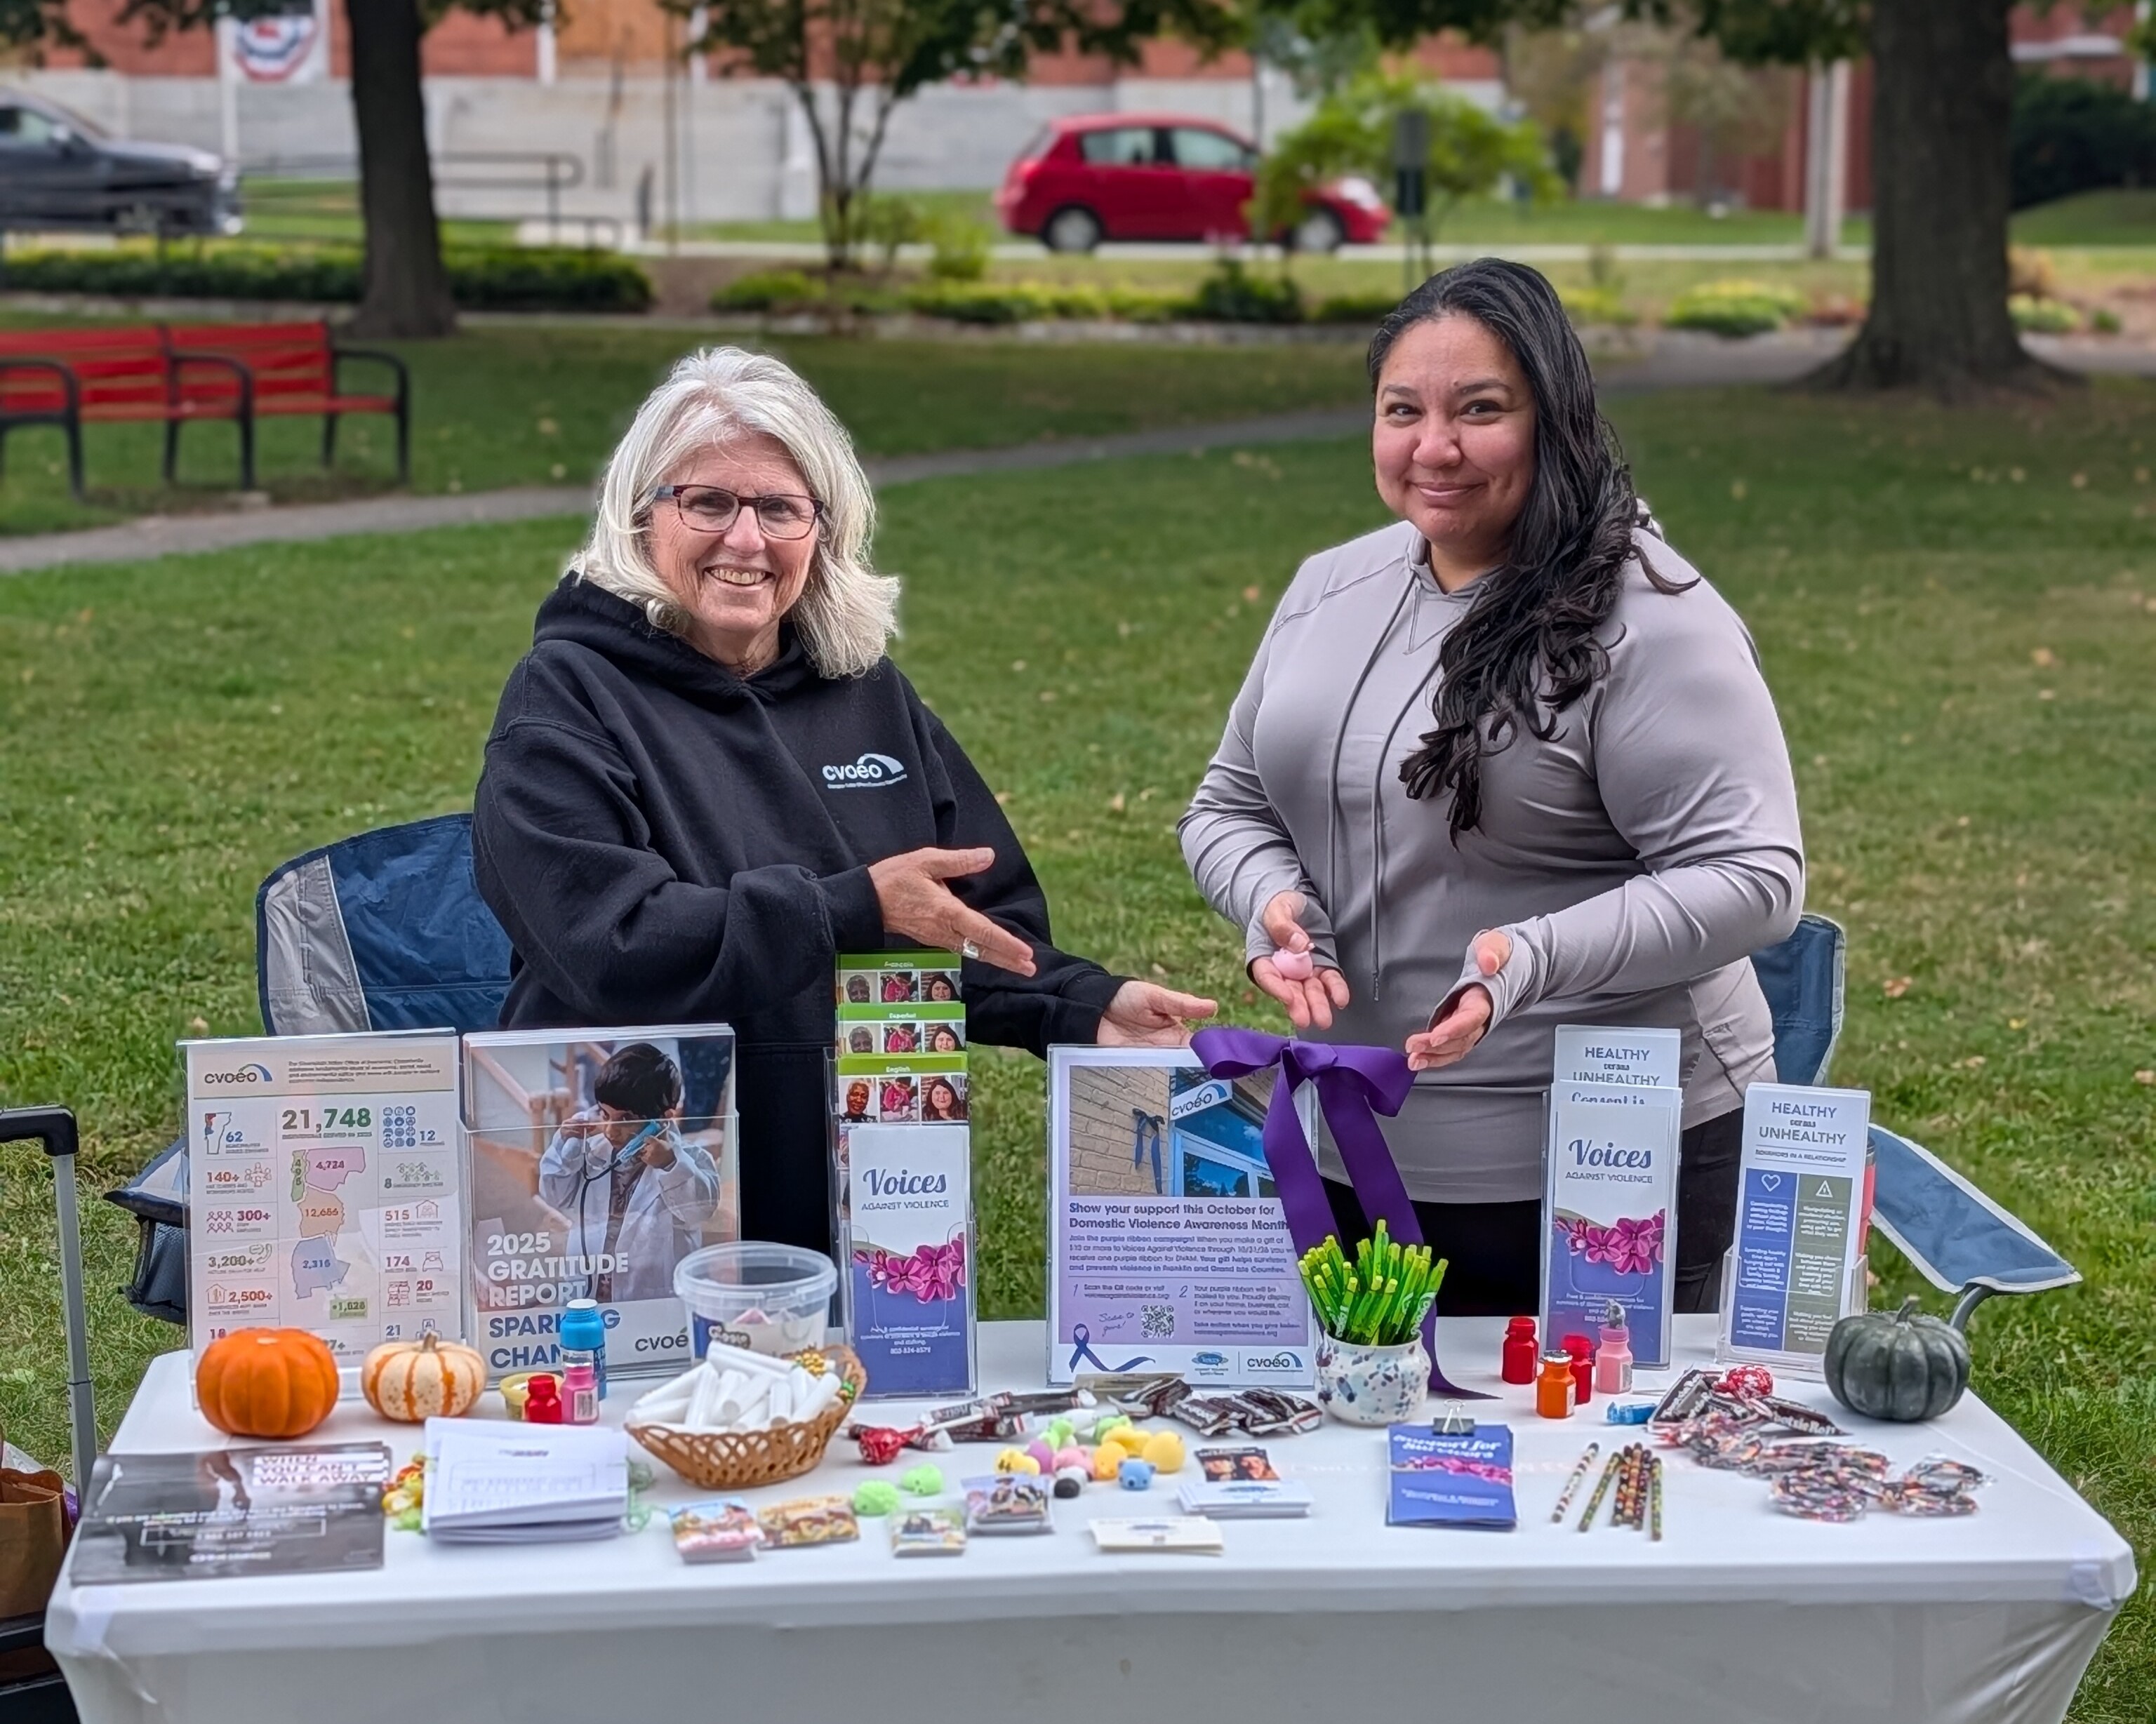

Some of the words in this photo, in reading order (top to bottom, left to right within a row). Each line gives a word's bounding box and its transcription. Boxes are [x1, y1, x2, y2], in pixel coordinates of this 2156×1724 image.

[1585, 1046, 1650, 1061] HEALTHY
[1573, 1071, 1661, 1086] UNHEALTHY
[1771, 1102, 1837, 1118] HEALTHY
[281, 1107, 372, 1132] 21,748
[225, 1131, 244, 1142] 62
[420, 1130, 436, 1141] 12
[1759, 1126, 1846, 1145] UNHEALTHY
[1569, 1140, 1651, 1168] Voices
[206, 1172, 239, 1183] 140+
[384, 1178, 392, 1189] 8
[863, 1168, 947, 1196] Voices
[1565, 1172, 1606, 1181] AGAINST
[1607, 1174, 1653, 1184] VIOLENCE
[861, 1201, 902, 1210] AGAINST
[903, 1200, 949, 1209] VIOLENCE
[1069, 1202, 1101, 1213] Show
[1105, 1204, 1131, 1215] your
[1133, 1204, 1180, 1216] support
[1183, 1204, 1204, 1215] this
[1207, 1204, 1256, 1215] October
[1259, 1205, 1275, 1215] for
[237, 1210, 271, 1221] 300+
[385, 1209, 410, 1221] 515
[1069, 1217, 1126, 1229] Domestic
[1129, 1218, 1180, 1229] Violence
[1183, 1219, 1249, 1230] Awareness
[487, 1231, 551, 1256] 2025
[1147, 1245, 1173, 1253] Against
[208, 1255, 255, 1269] 3,200+
[386, 1256, 411, 1267] 174
[488, 1252, 628, 1281] GRATITUDE
[416, 1280, 433, 1291] 20
[1179, 1285, 1188, 1298] 2
[228, 1290, 273, 1304] 2,500+
[489, 1281, 587, 1307] REPORT
[385, 1324, 401, 1336] 21
[488, 1309, 621, 1338] SPARG
[262, 1455, 318, 1465] WHEN
[262, 1465, 299, 1474] YOU
[260, 1476, 311, 1484] WALK
[319, 1474, 370, 1483] AWAY
